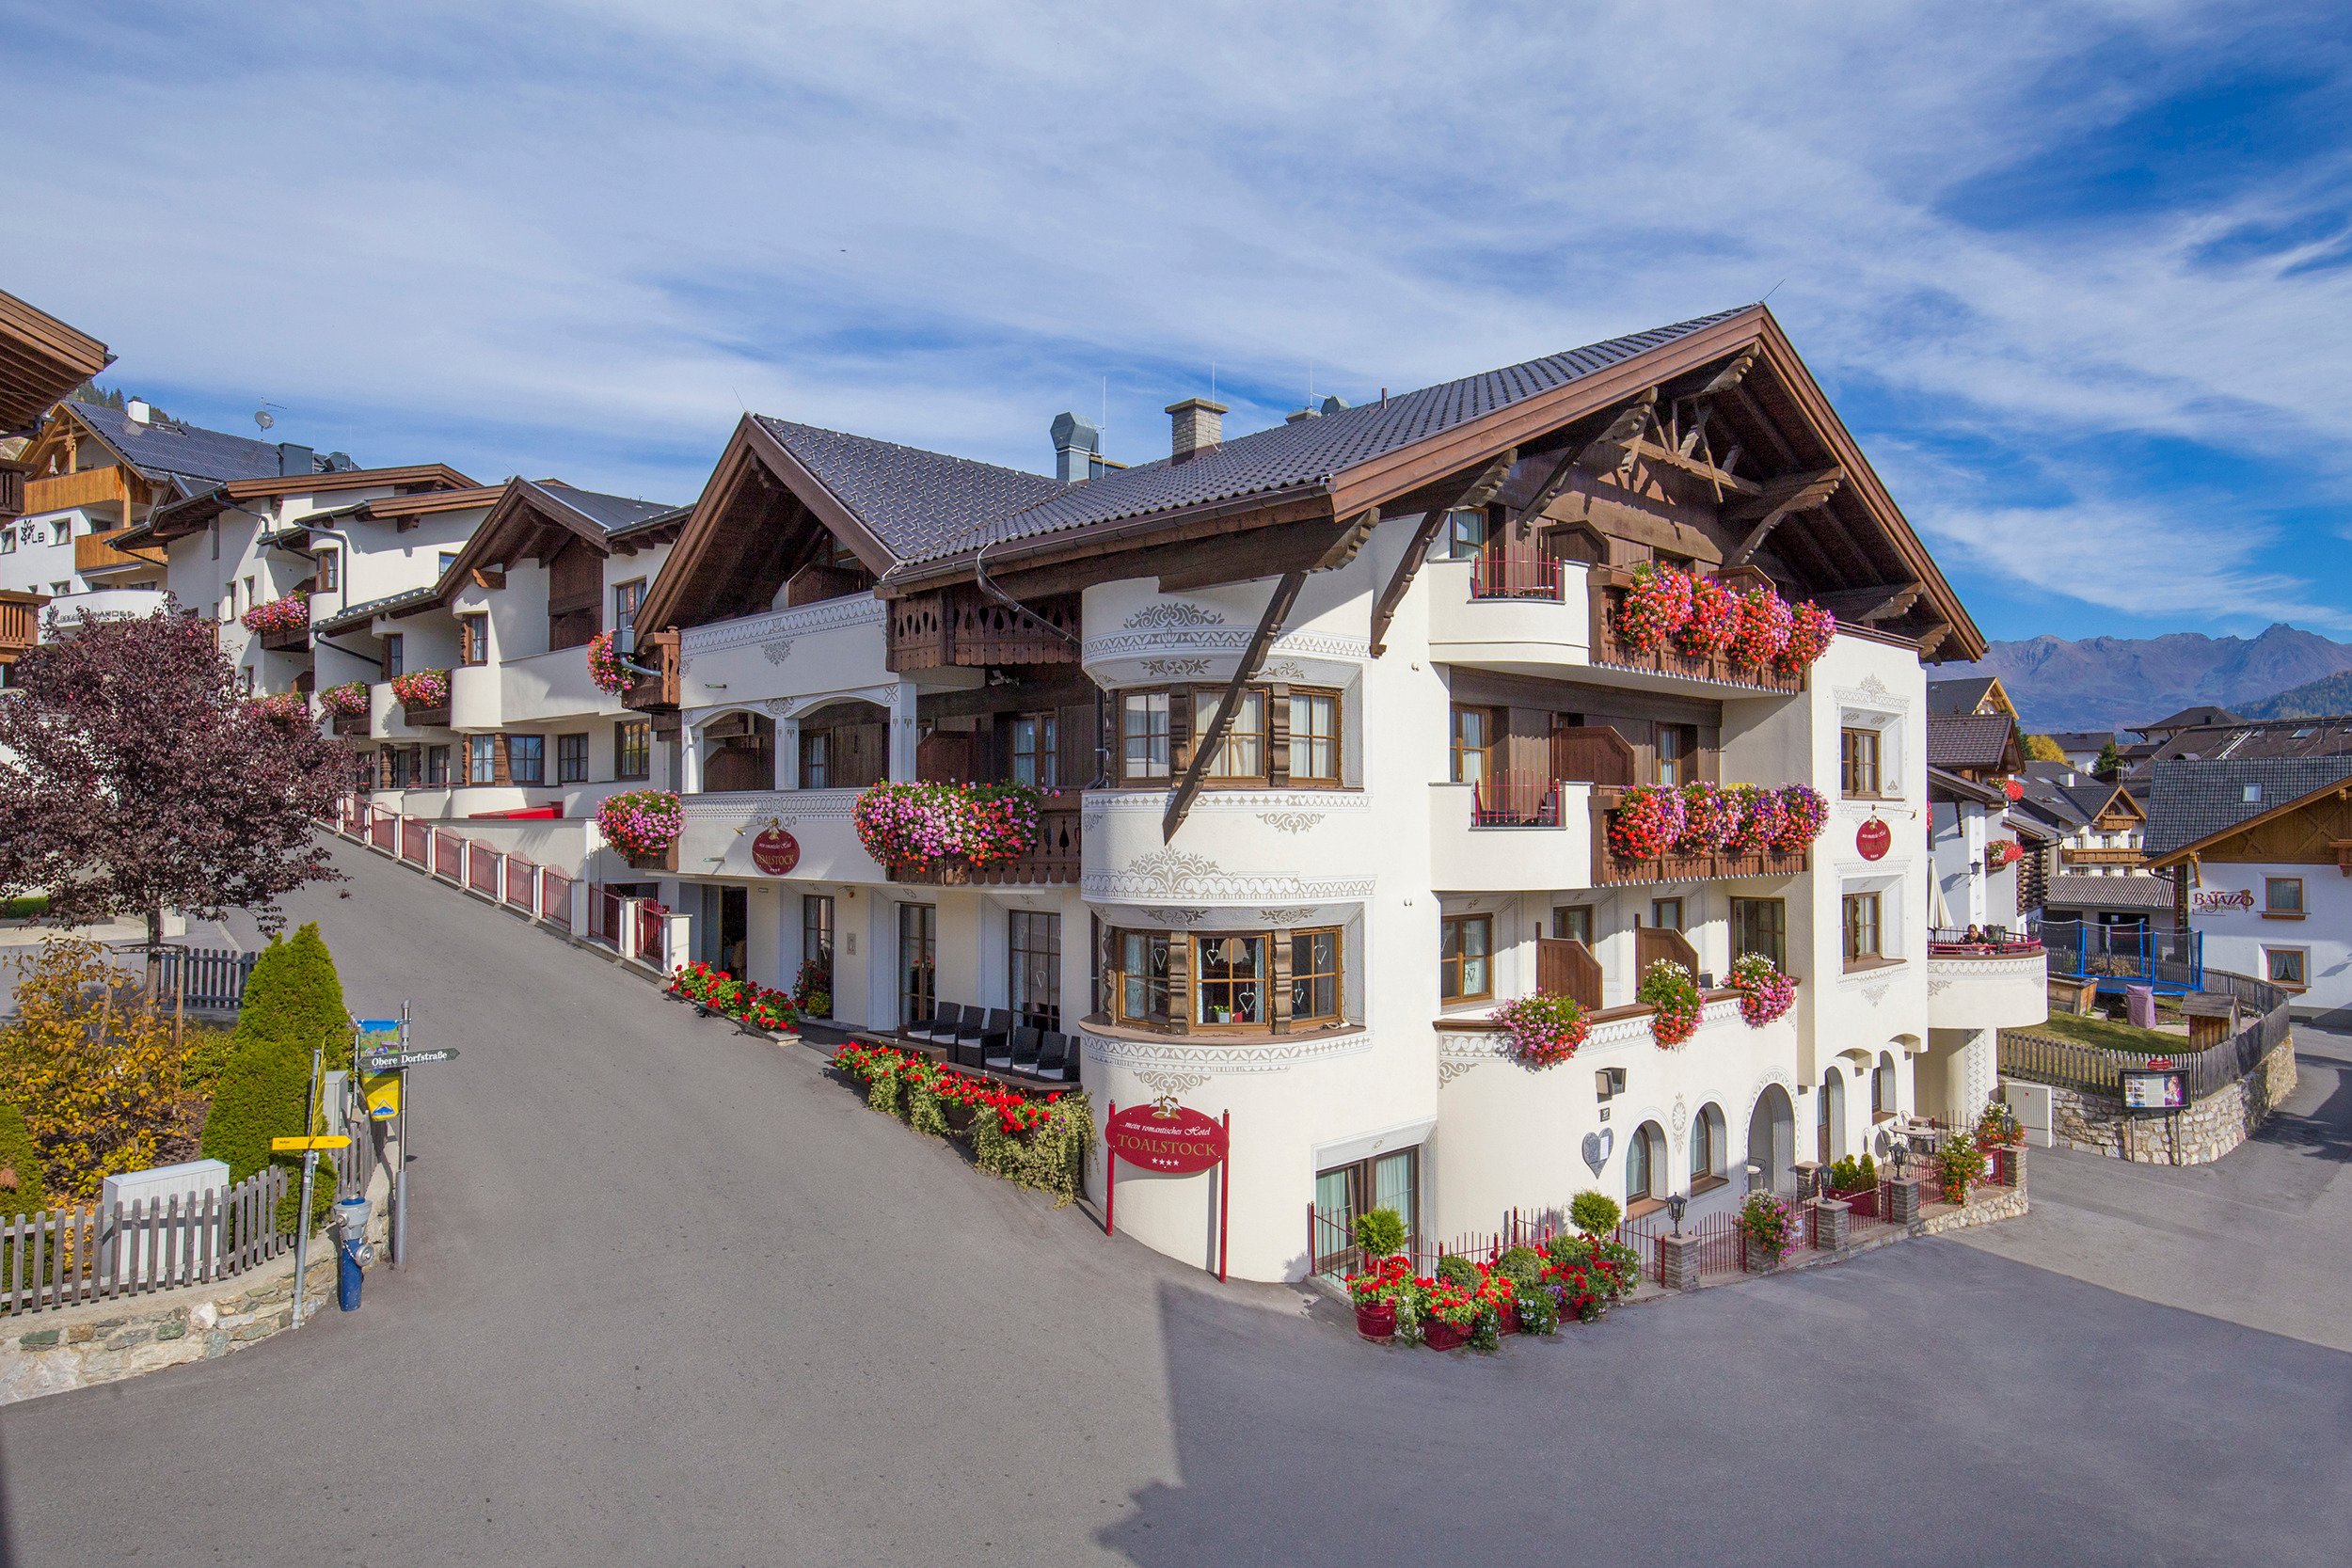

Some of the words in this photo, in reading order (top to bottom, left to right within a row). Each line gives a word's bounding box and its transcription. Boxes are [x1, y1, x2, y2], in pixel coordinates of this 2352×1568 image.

[32, 531, 44, 544] LB
[372, 1056, 398, 1067] Obere
[401, 1051, 448, 1063] Dorfstraße
[1141, 1124, 1183, 1135] romantisches
[1184, 1126, 1212, 1136] Hotel
[1117, 1133, 1218, 1157] TOALSTOCK
